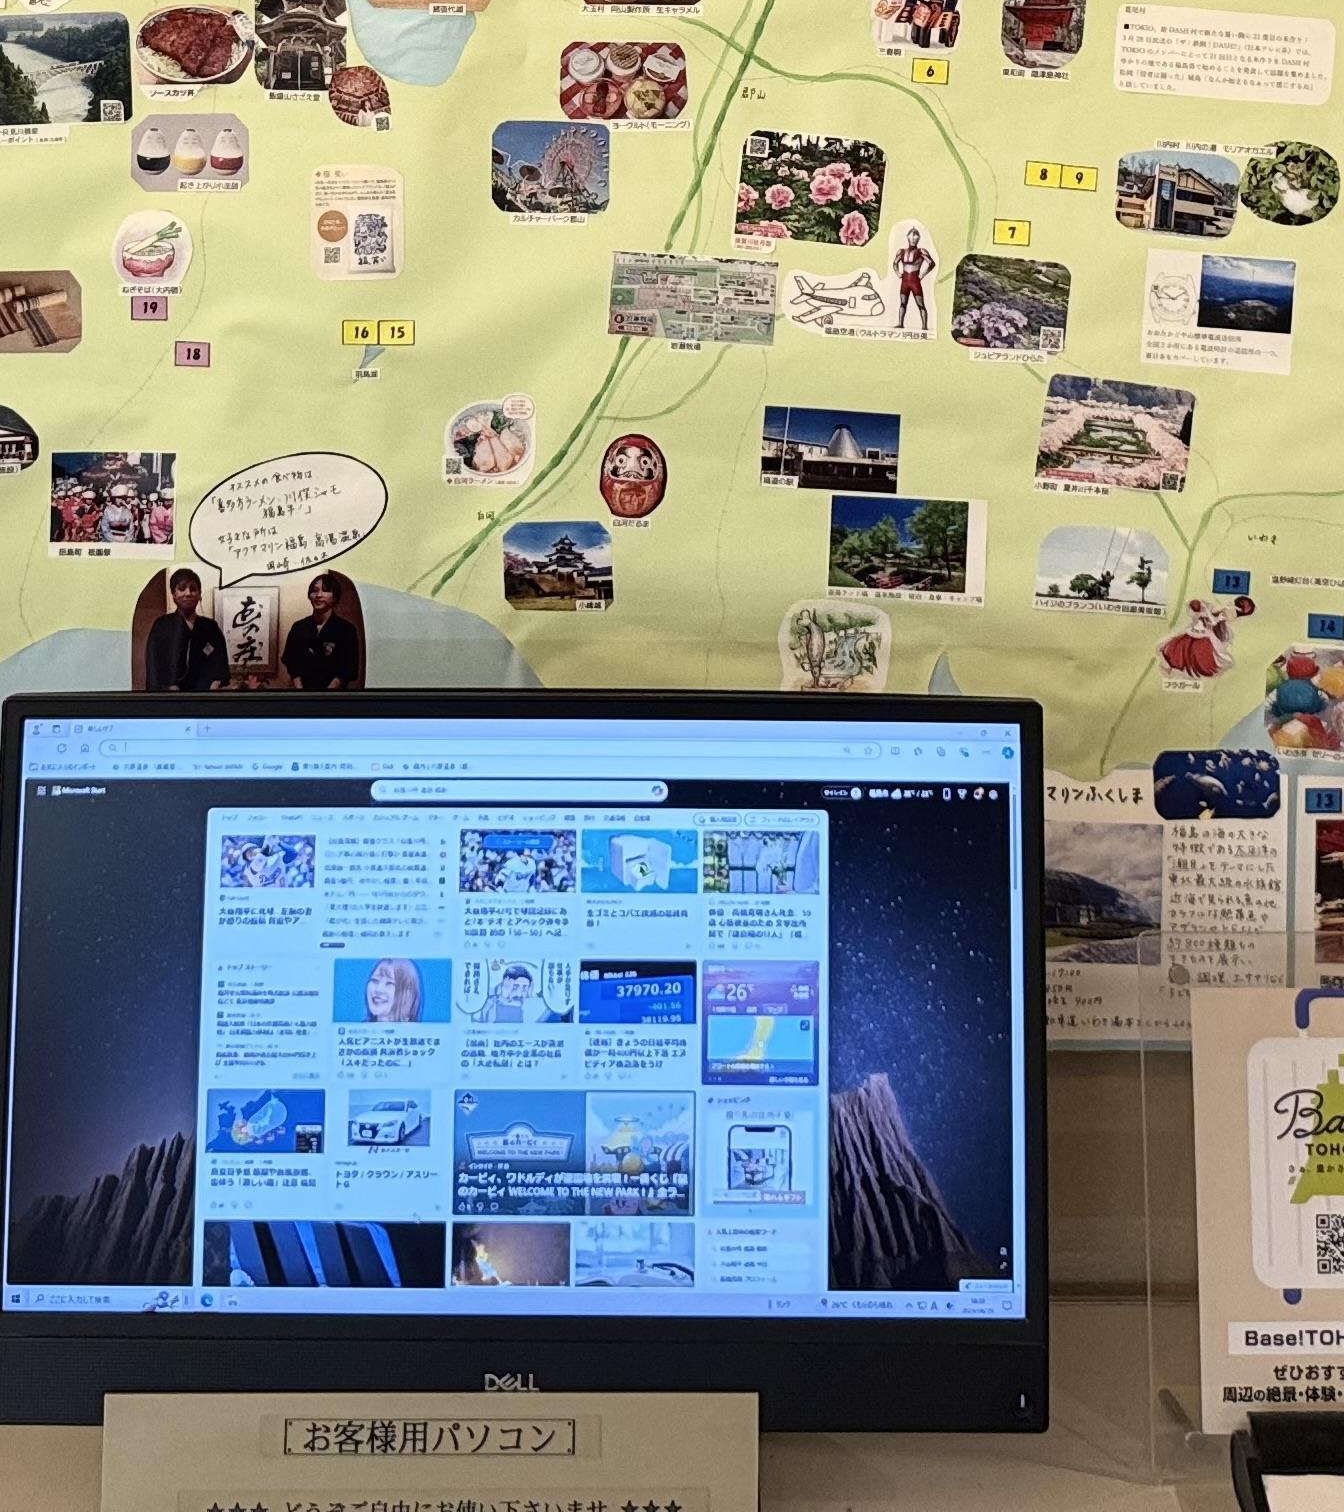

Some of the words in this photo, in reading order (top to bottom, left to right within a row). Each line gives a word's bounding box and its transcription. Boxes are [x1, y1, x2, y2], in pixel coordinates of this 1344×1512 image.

[926, 65, 935, 78] 6
[1039, 168, 1049, 181] 8
[1075, 171, 1084, 185] 9
[1008, 226, 1017, 239] 7
[143, 301, 158, 314] 19
[354, 326, 369, 339] 16
[390, 326, 405, 339] 15
[186, 347, 201, 361] 18
[617, 982, 681, 998] 37970.20
[484, 1372, 540, 1392] DELL
[303, 1418, 556, 1456] お客様用パソコン
